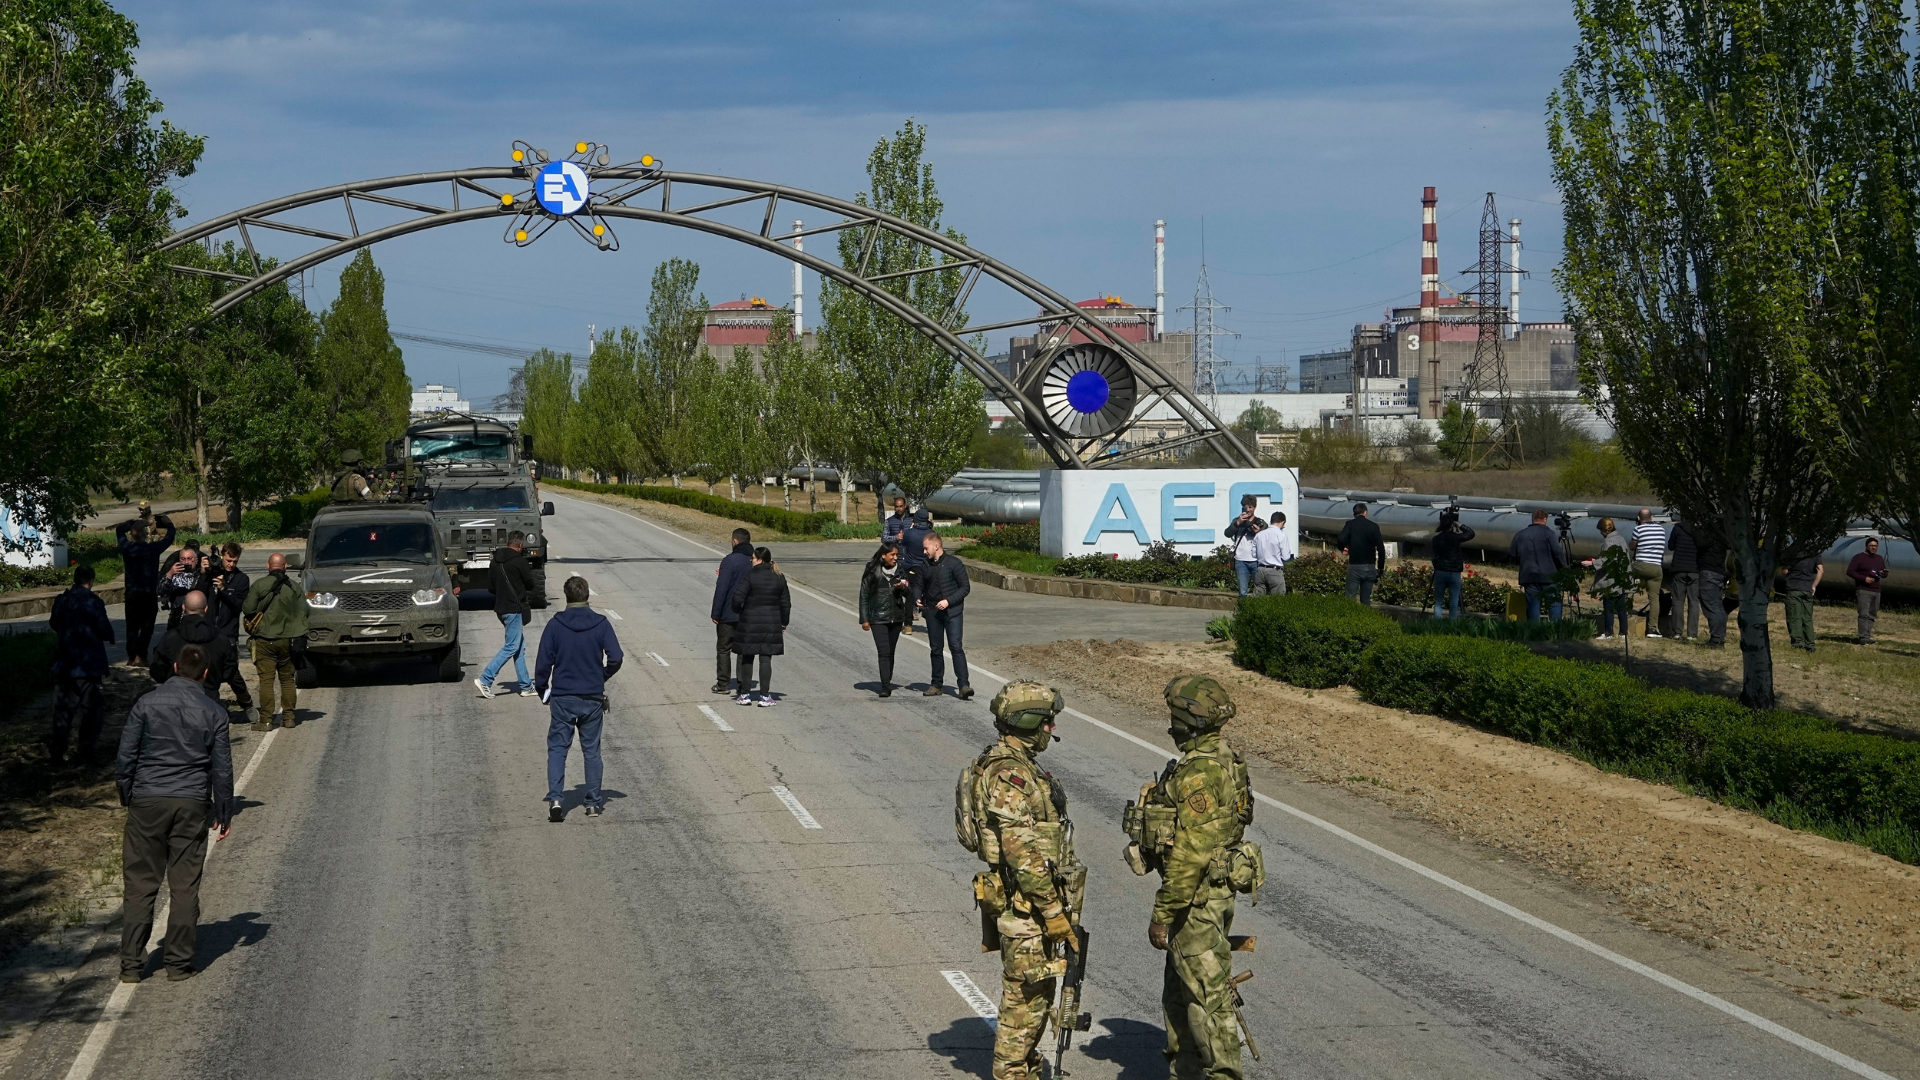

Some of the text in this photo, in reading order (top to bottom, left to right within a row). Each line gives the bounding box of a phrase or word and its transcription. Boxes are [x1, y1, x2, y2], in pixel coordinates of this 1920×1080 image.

[1407, 334, 1420, 350] 3
[458, 518, 497, 527] Z
[342, 567, 413, 583] Z
[360, 614, 387, 635] Z
